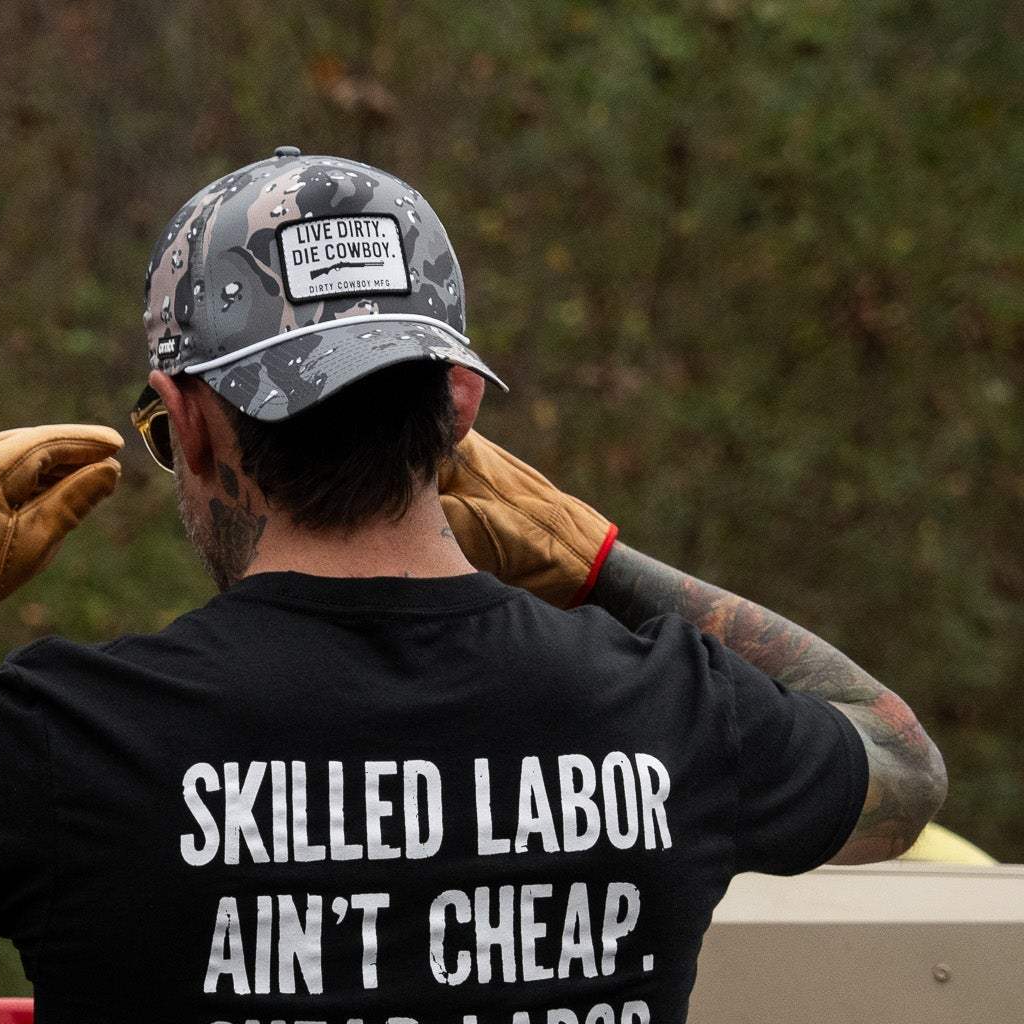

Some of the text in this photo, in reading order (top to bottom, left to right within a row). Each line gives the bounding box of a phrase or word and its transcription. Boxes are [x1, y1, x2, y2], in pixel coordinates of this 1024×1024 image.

[296, 219, 386, 244] LIVE DIRTY.
[292, 241, 396, 266] DIE COWBOY.
[309, 279, 391, 294] DIRTY COWBOY MFG
[180, 750, 673, 867] SKILLED LABOR
[203, 881, 655, 996] AIN’T CHEAP.
